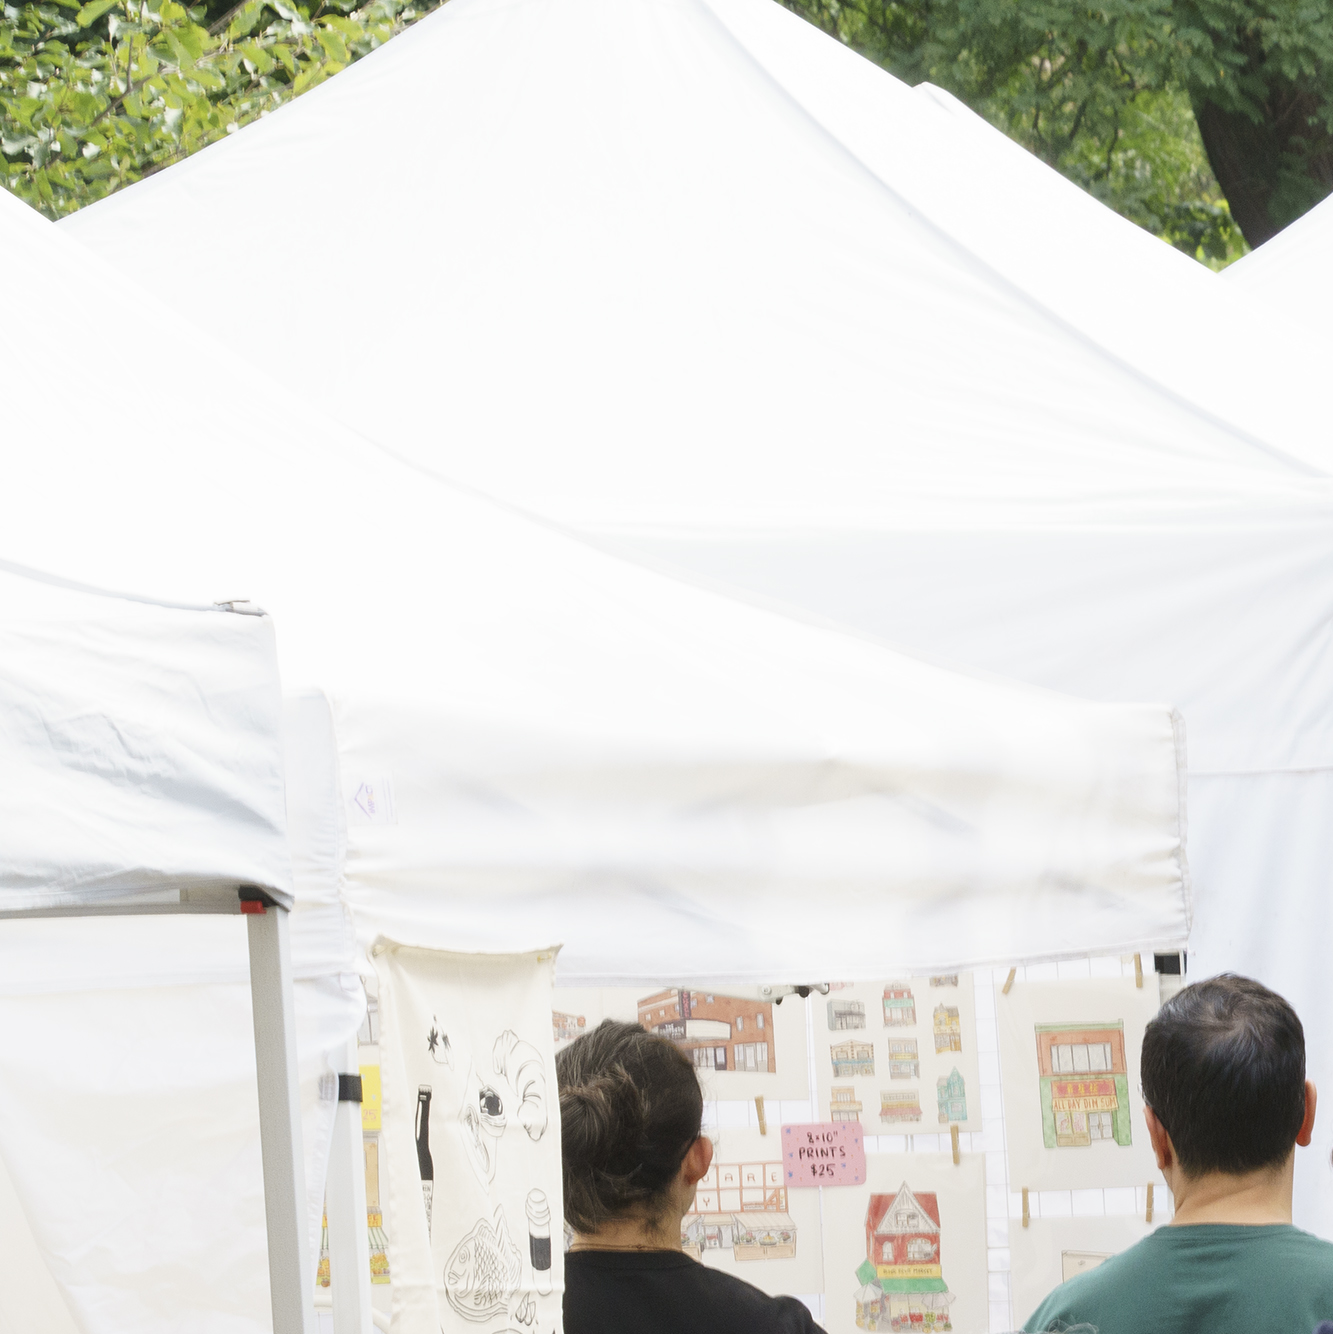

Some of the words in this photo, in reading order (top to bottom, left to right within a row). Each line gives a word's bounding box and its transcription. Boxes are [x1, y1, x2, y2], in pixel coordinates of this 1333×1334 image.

[1054, 1101, 1065, 1110] ALL
[1068, 1099, 1081, 1110] DAY
[1084, 1098, 1099, 1109] DIM
[1101, 1097, 1117, 1108] SUM
[799, 1147, 846, 1159] PRINTS
[811, 1164, 835, 1178] $25
